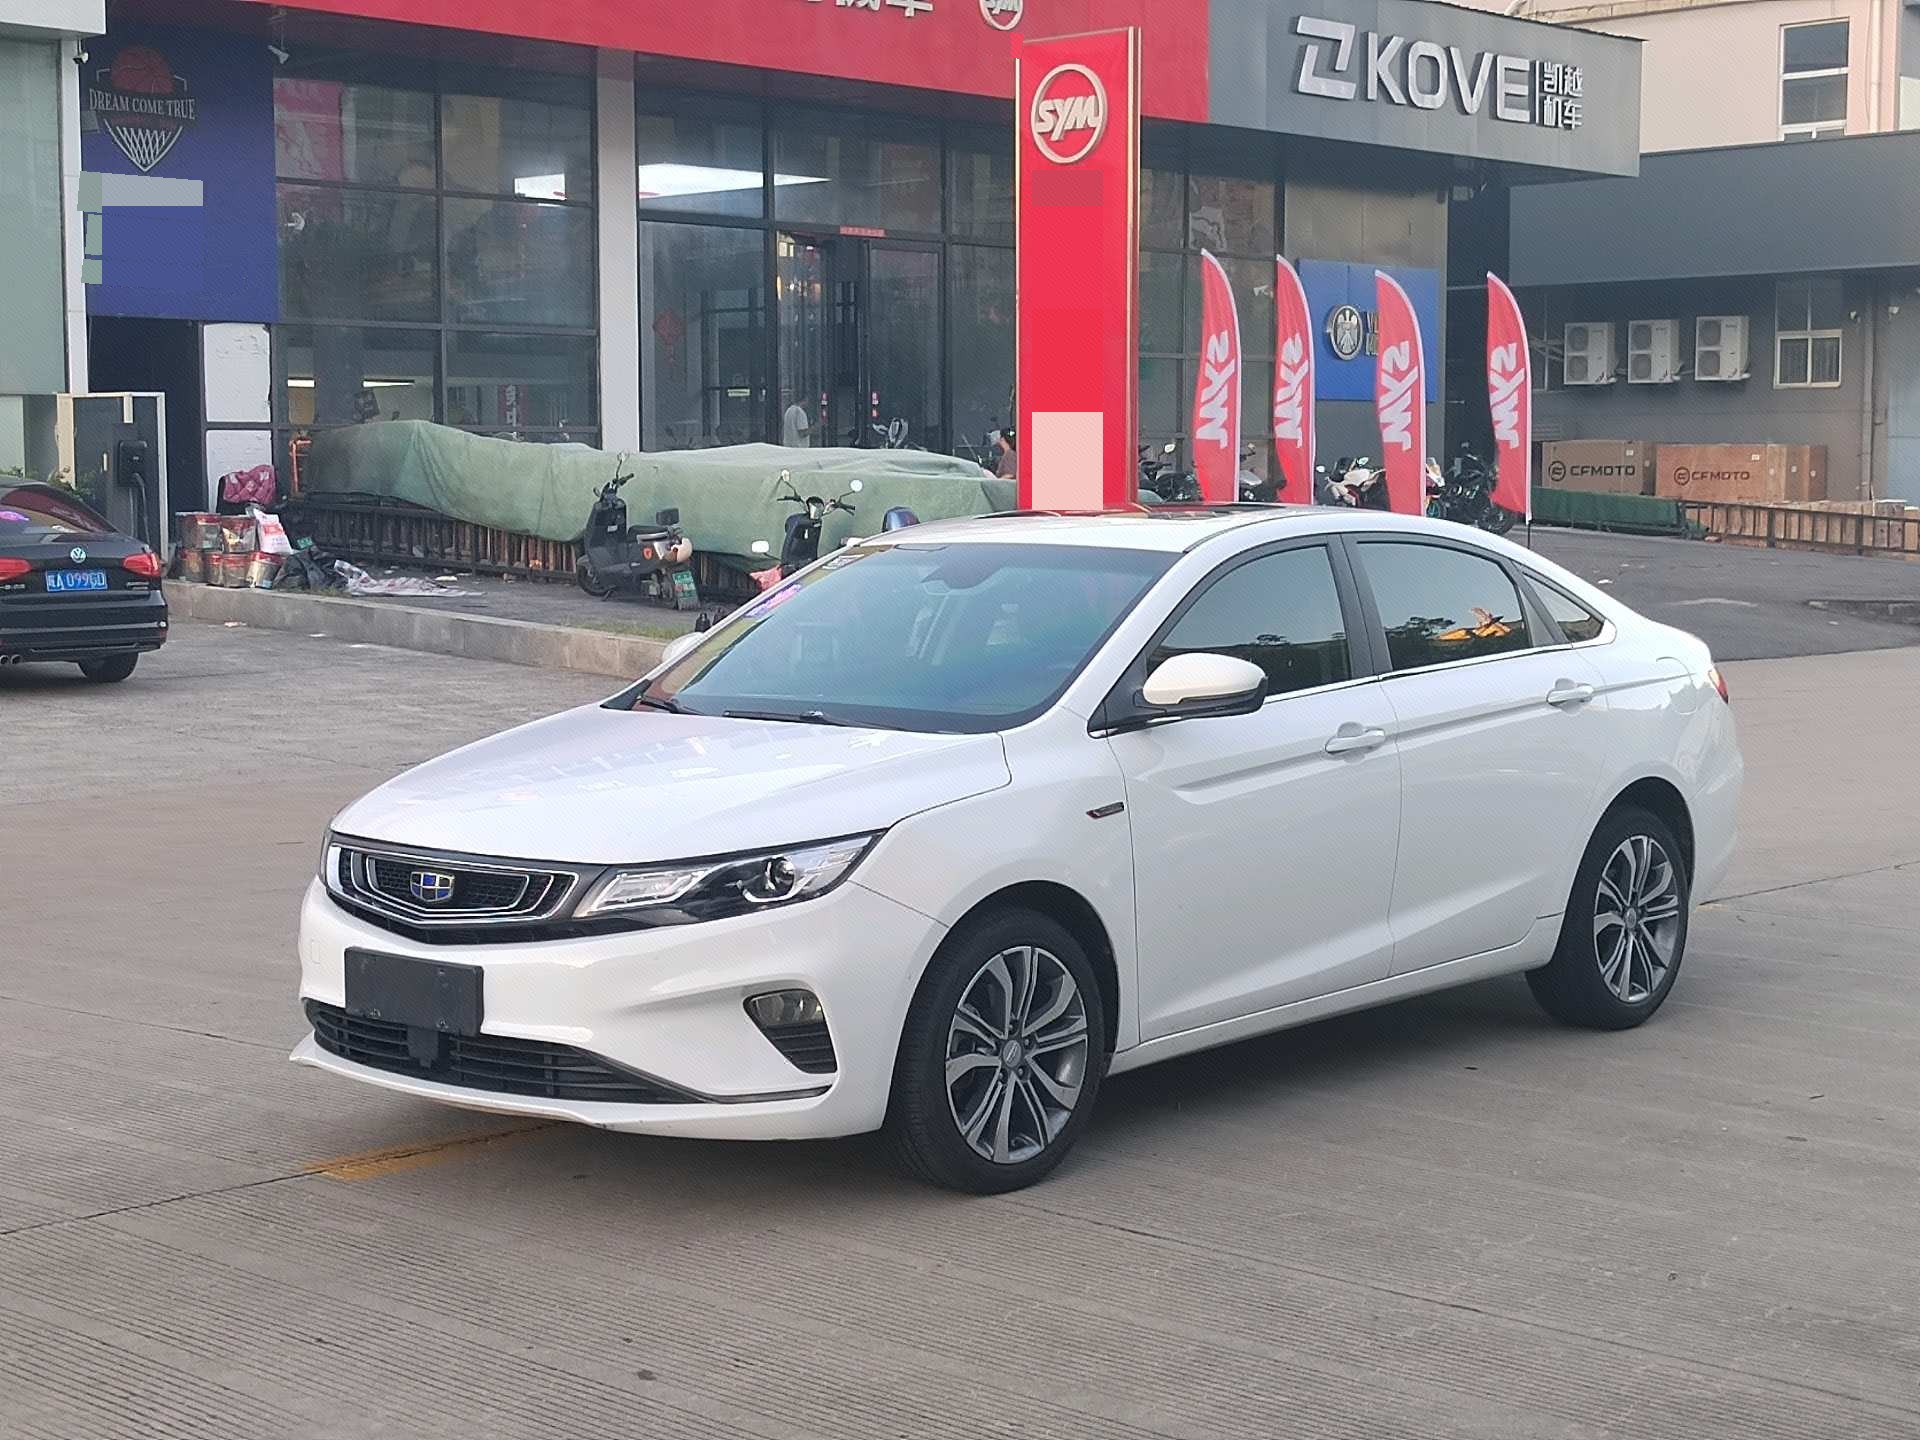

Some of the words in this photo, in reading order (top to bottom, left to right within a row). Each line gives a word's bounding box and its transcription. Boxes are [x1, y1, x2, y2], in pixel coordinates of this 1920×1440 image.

[1367, 31, 1531, 123] KOVE
[1543, 61, 1583, 97] 凯越
[89, 88, 130, 112] DREAM
[132, 97, 164, 115] COME
[166, 98, 196, 120] TRUE
[1035, 94, 1100, 141] SYM
[1543, 95, 1583, 130] 机车
[1570, 465, 1636, 476] CFMOTO
[1691, 471, 1750, 481] CFMOTO
